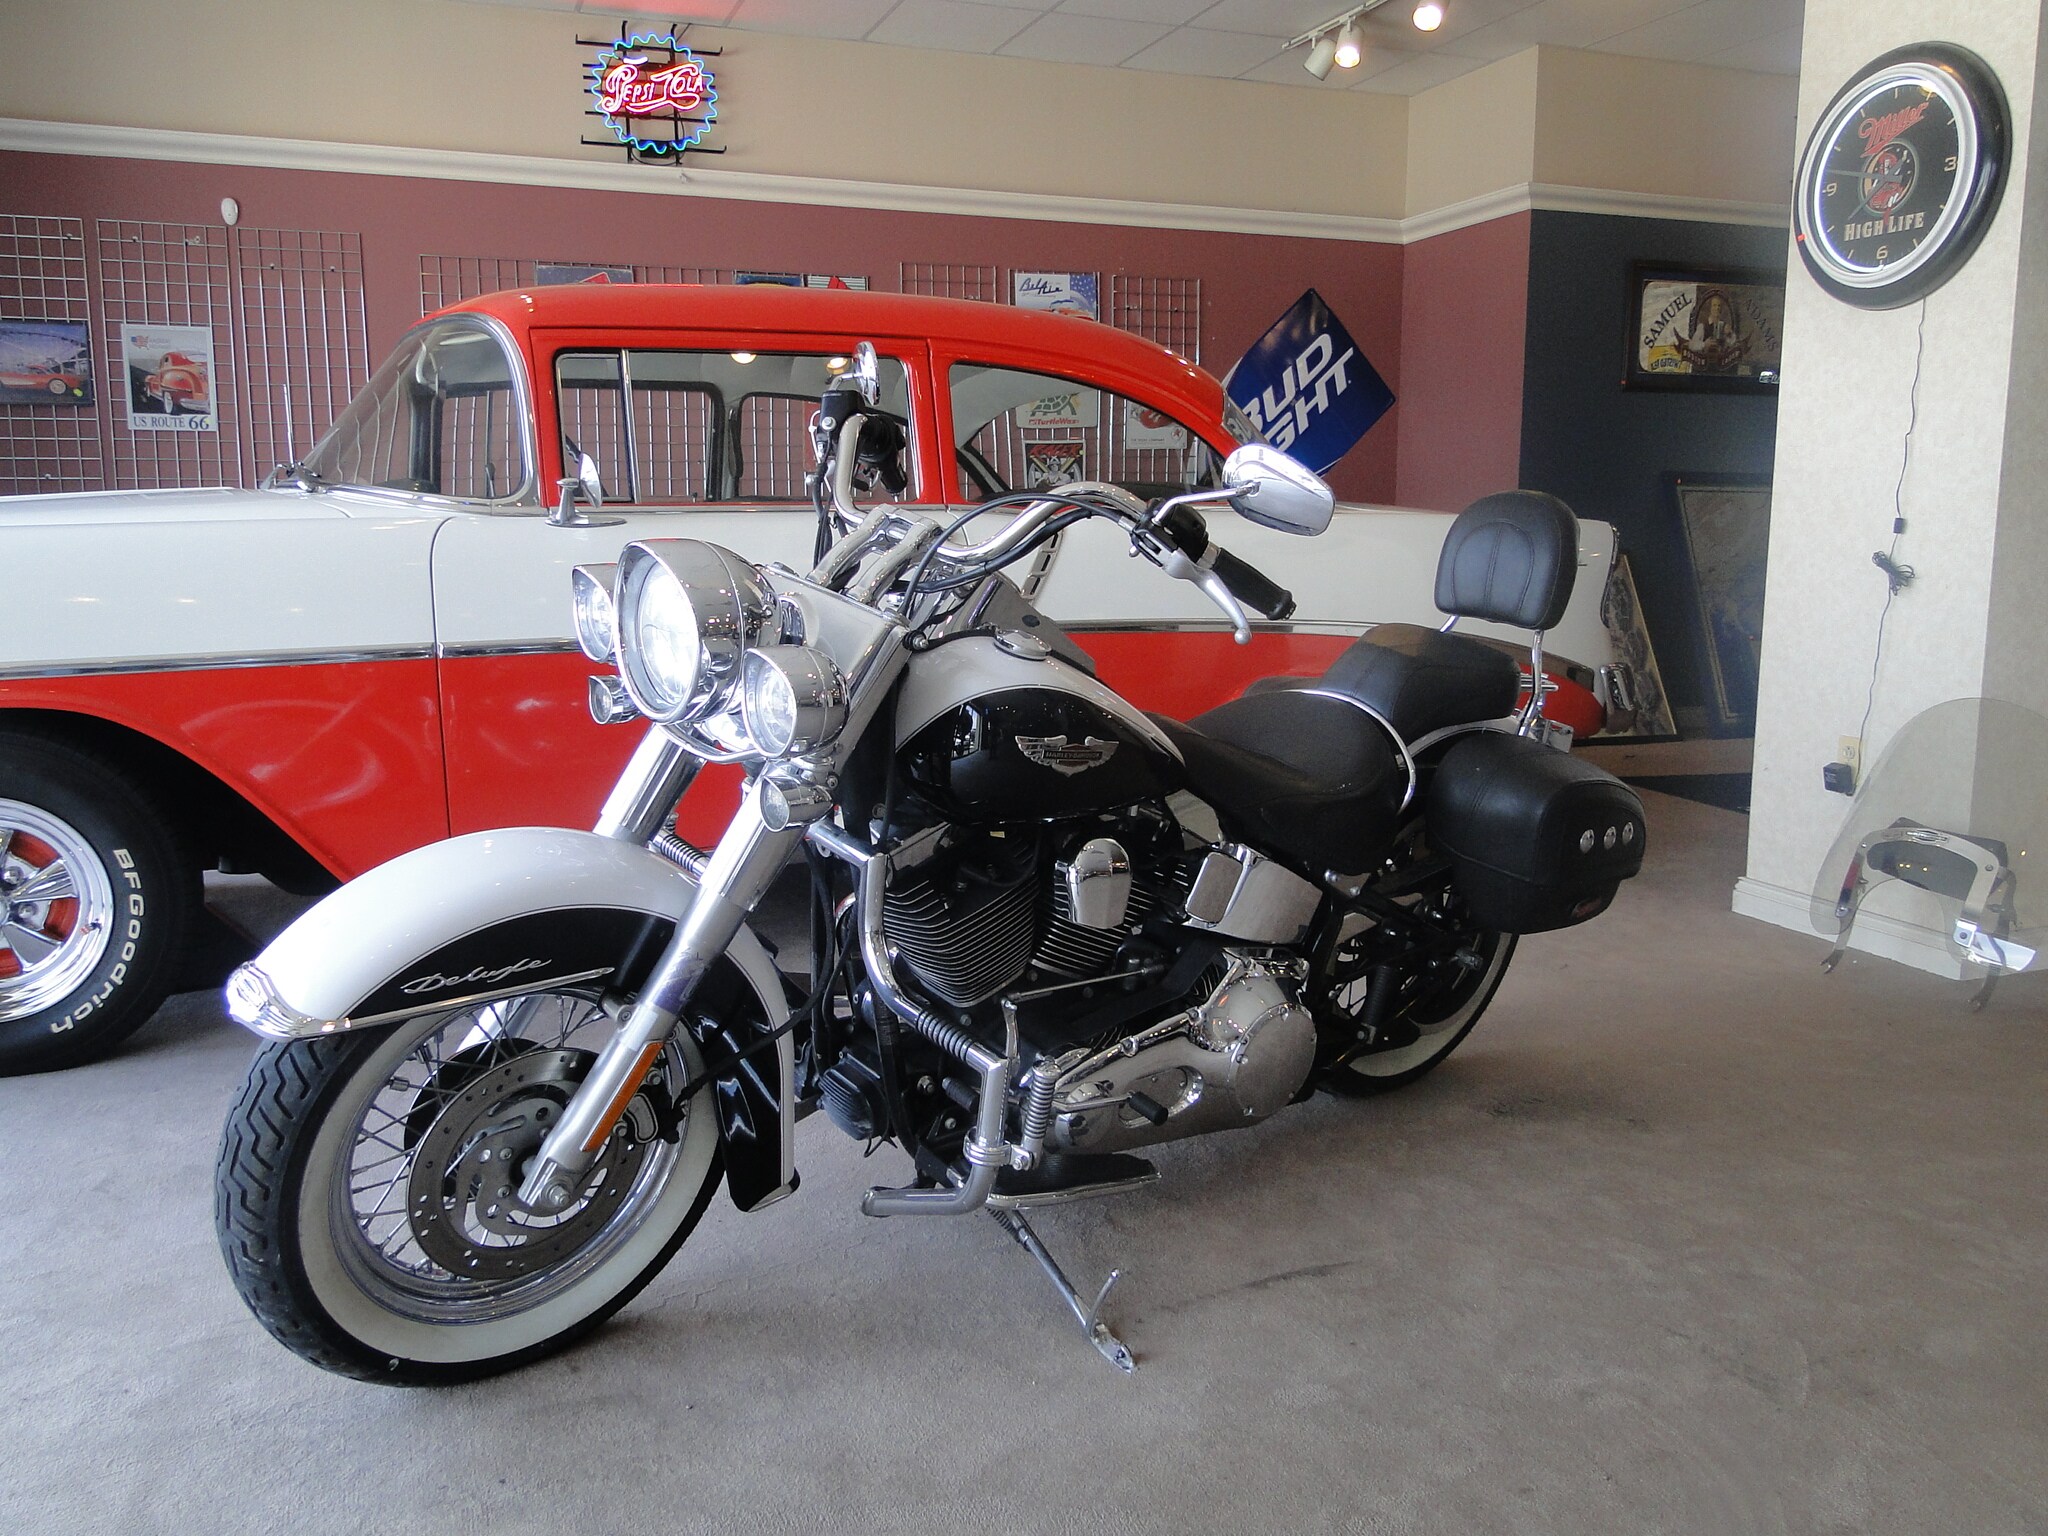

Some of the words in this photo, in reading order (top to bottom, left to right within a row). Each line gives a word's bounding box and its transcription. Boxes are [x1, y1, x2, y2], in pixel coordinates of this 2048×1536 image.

[1857, 101, 1930, 159] Miller
[1943, 156, 1958, 172] 3
[1825, 182, 1837, 197] 9
[1843, 218, 1884, 242] HIGH
[1886, 211, 1925, 234] LIFE
[1876, 245, 1888, 260] 6
[1643, 292, 1693, 349] SAMUEL
[1744, 297, 1778, 352] ADAMS
[1241, 332, 1333, 434] BUD
[1263, 346, 1355, 453] GHT
[133, 416, 147, 427] US
[151, 417, 186, 428] ROUTE
[188, 415, 209, 430] 66
[50, 848, 146, 1034] BFGoodrich
